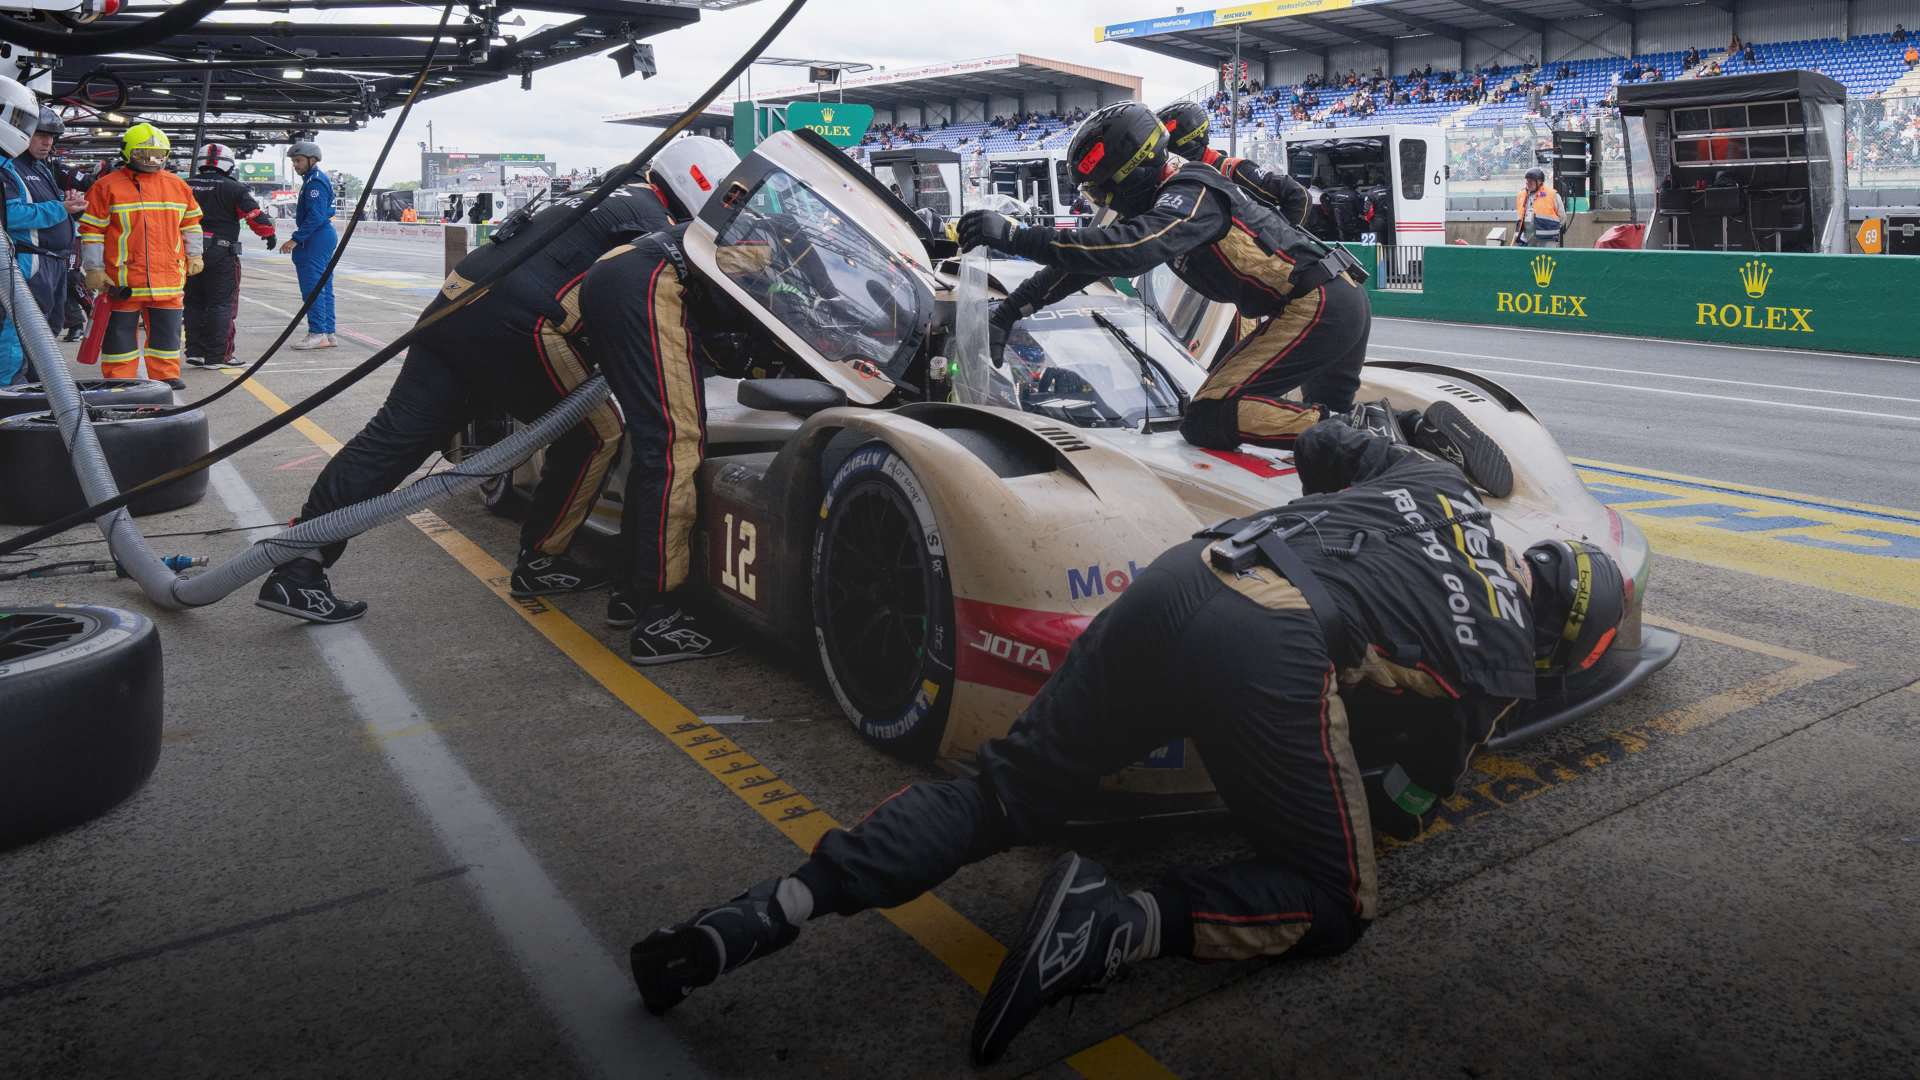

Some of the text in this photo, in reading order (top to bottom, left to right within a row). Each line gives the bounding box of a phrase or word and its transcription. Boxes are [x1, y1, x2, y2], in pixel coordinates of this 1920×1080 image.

[1433, 170, 1441, 185] 6
[1361, 233, 1376, 246] 22
[664, 242, 688, 280] JOTA
[1497, 292, 1588, 317] ROLEX
[1696, 303, 1815, 332] ROLEX
[833, 452, 881, 490] MICHELIN
[904, 477, 922, 503] SPORT
[722, 513, 756, 600] 12
[1448, 490, 1526, 629] Hertz
[1443, 573, 1479, 646] Gold
[970, 630, 1051, 671] JOTA
[866, 706, 919, 739] MICHELIN
